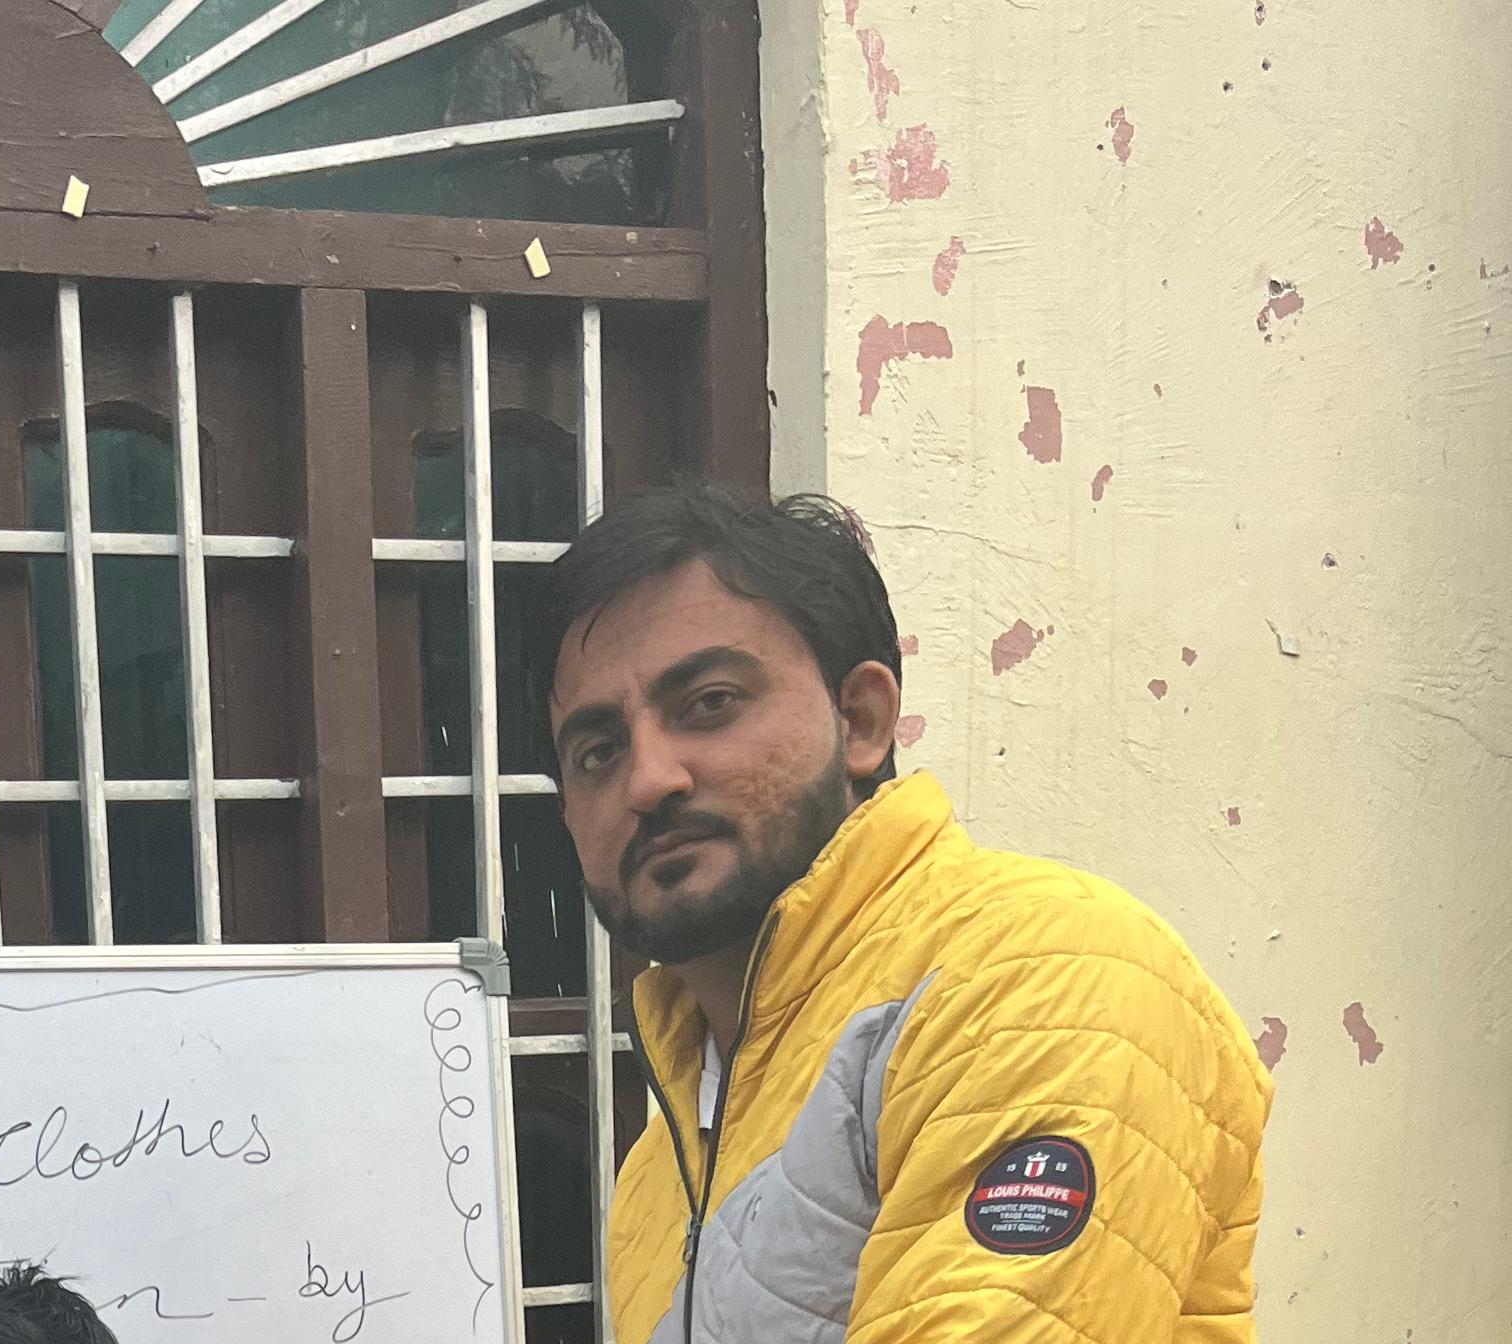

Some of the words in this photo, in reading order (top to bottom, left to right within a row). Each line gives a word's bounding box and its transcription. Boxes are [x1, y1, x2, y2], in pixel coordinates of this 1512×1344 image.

[986, 1184, 1021, 1199] LOUIS
[1021, 1184, 1071, 1201] PHILIPPE
[297, 1239, 412, 1344] by
